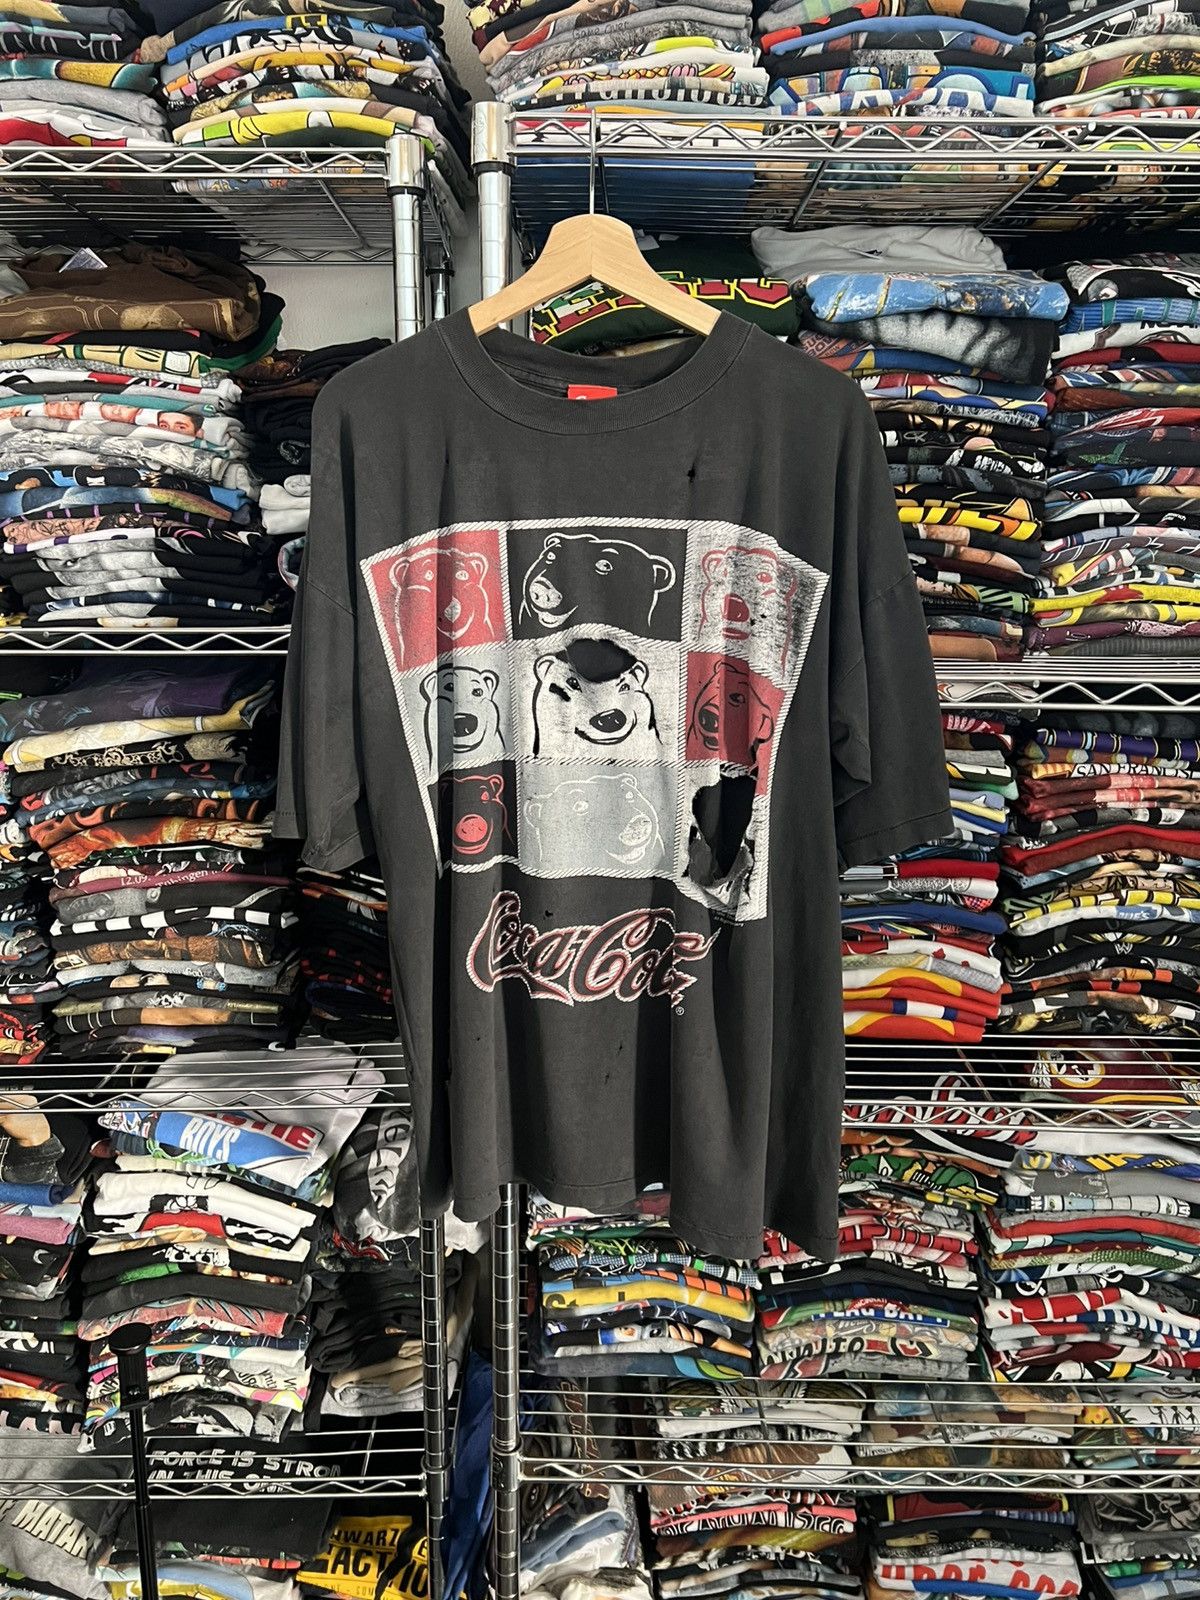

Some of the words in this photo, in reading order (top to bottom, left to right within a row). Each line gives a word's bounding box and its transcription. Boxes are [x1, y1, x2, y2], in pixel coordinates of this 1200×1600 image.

[179, 1116, 242, 1163] BOYS
[150, 1448, 226, 1467] FORCE
[231, 1450, 257, 1467] IS
[183, 1469, 235, 1488] THIS
